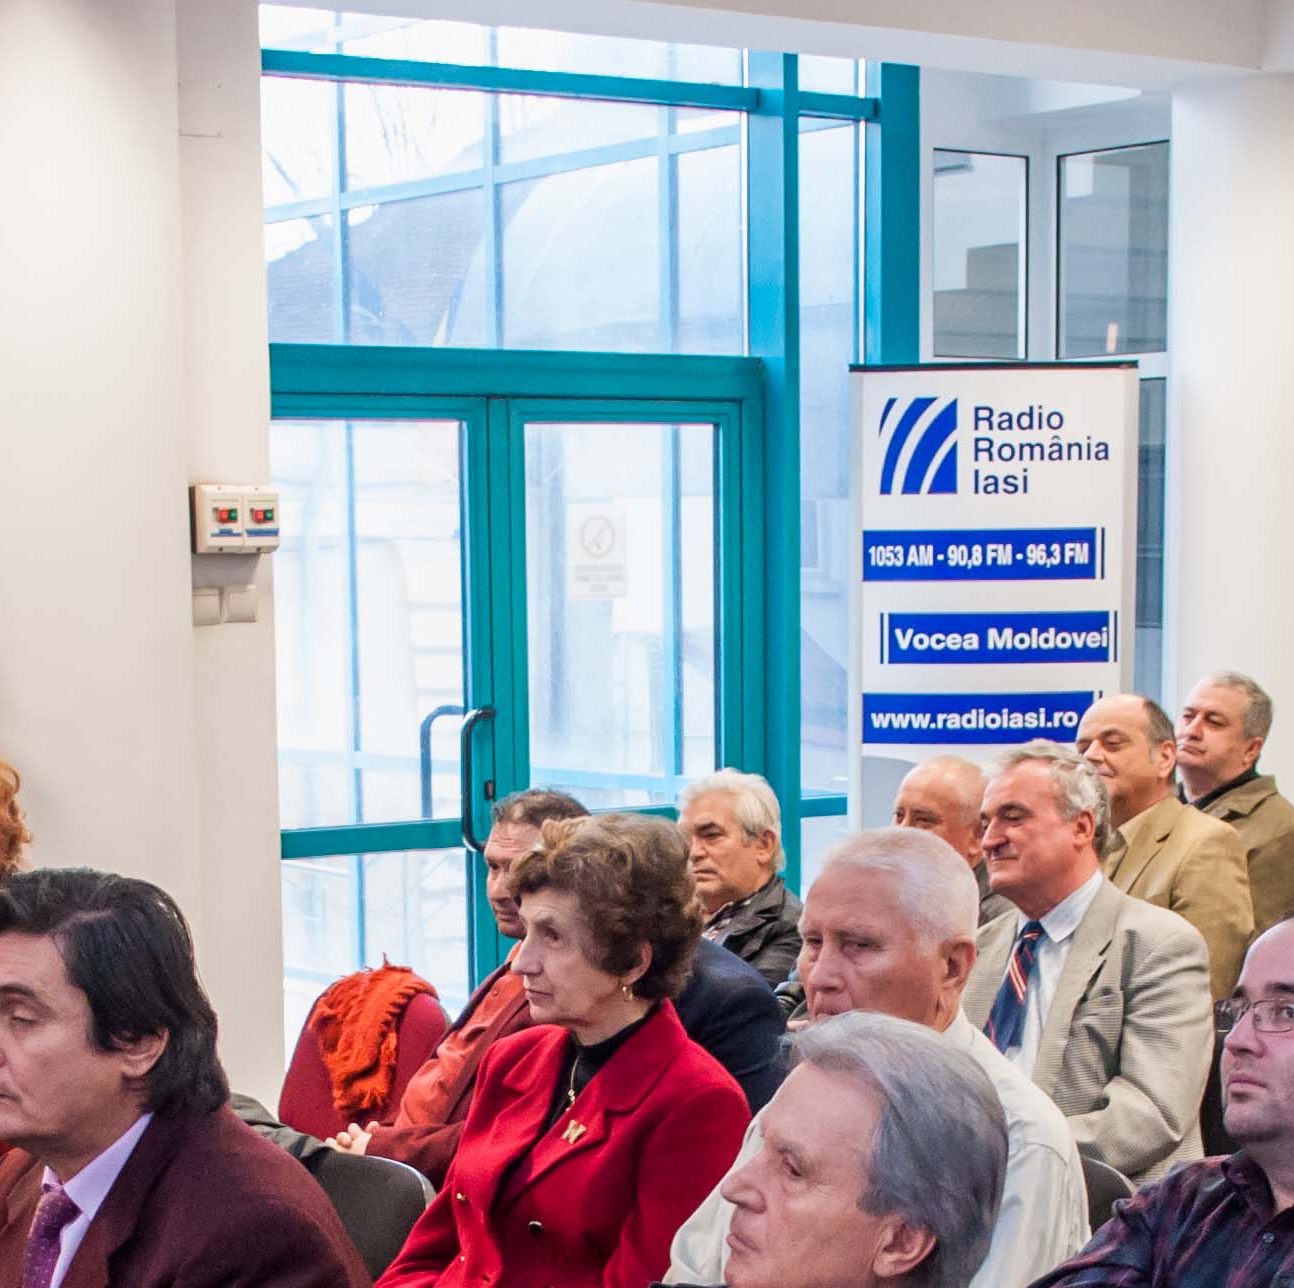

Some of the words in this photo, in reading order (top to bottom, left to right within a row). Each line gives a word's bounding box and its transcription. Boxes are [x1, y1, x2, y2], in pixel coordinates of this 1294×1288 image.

[973, 404, 1064, 431] Radio
[973, 435, 1110, 462] România
[973, 468, 1029, 495] Iasi
[867, 545, 904, 567] 1053
[906, 544, 934, 566] AM
[947, 544, 983, 569] 90,8
[986, 543, 1013, 566] FM
[1026, 543, 1061, 569] 96,3
[1063, 542, 1090, 565] FM
[894, 627, 980, 650] Vocea
[986, 626, 1109, 650] Moldovei
[870, 707, 1079, 730] www.radioiasi.ro
